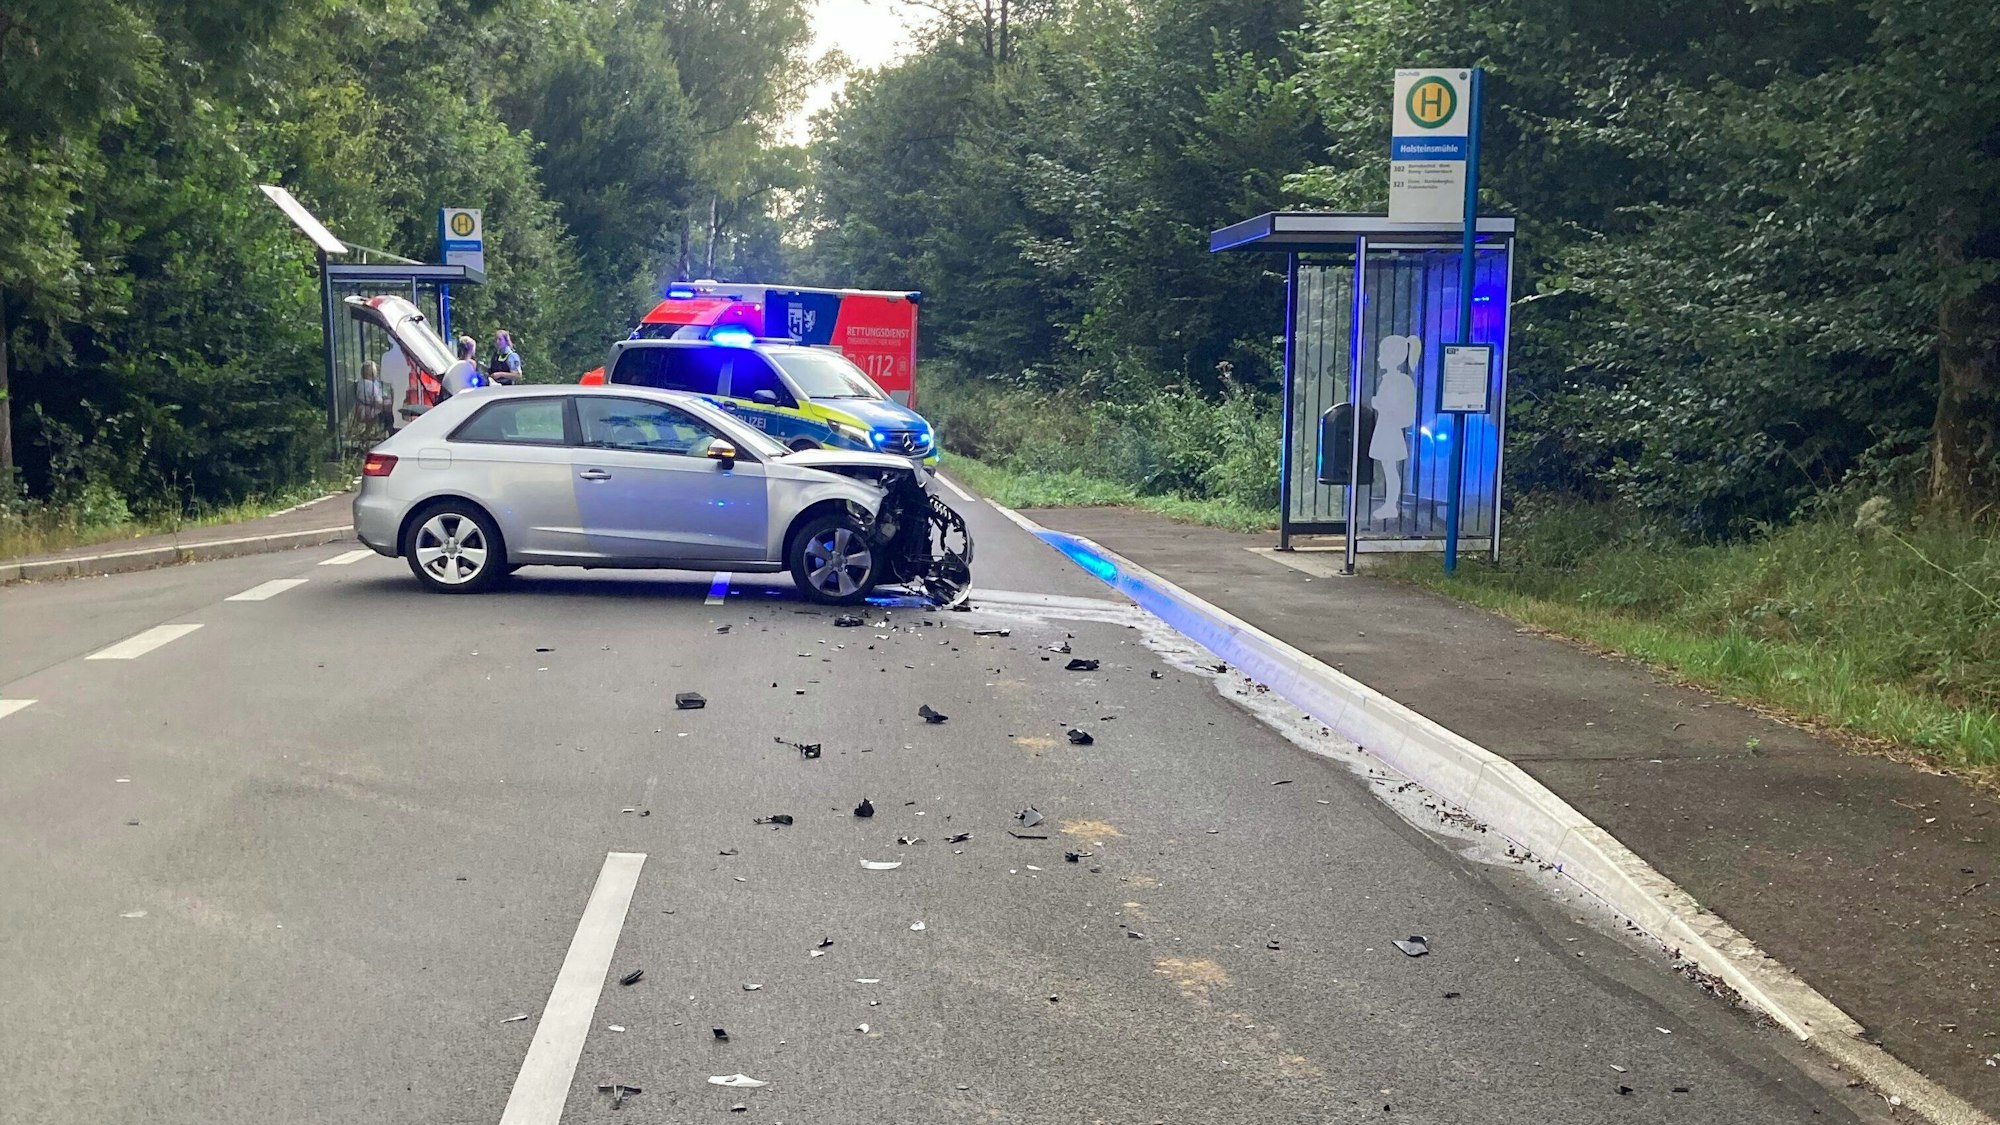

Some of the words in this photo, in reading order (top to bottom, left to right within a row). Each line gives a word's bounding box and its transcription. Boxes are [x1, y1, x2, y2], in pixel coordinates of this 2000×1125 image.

[1421, 87, 1442, 117] H
[1400, 144, 1459, 153] Holsteinsmühle
[458, 217, 468, 231] H
[847, 326, 910, 338] RETTUNGSDIENST
[868, 354, 894, 377] 112
